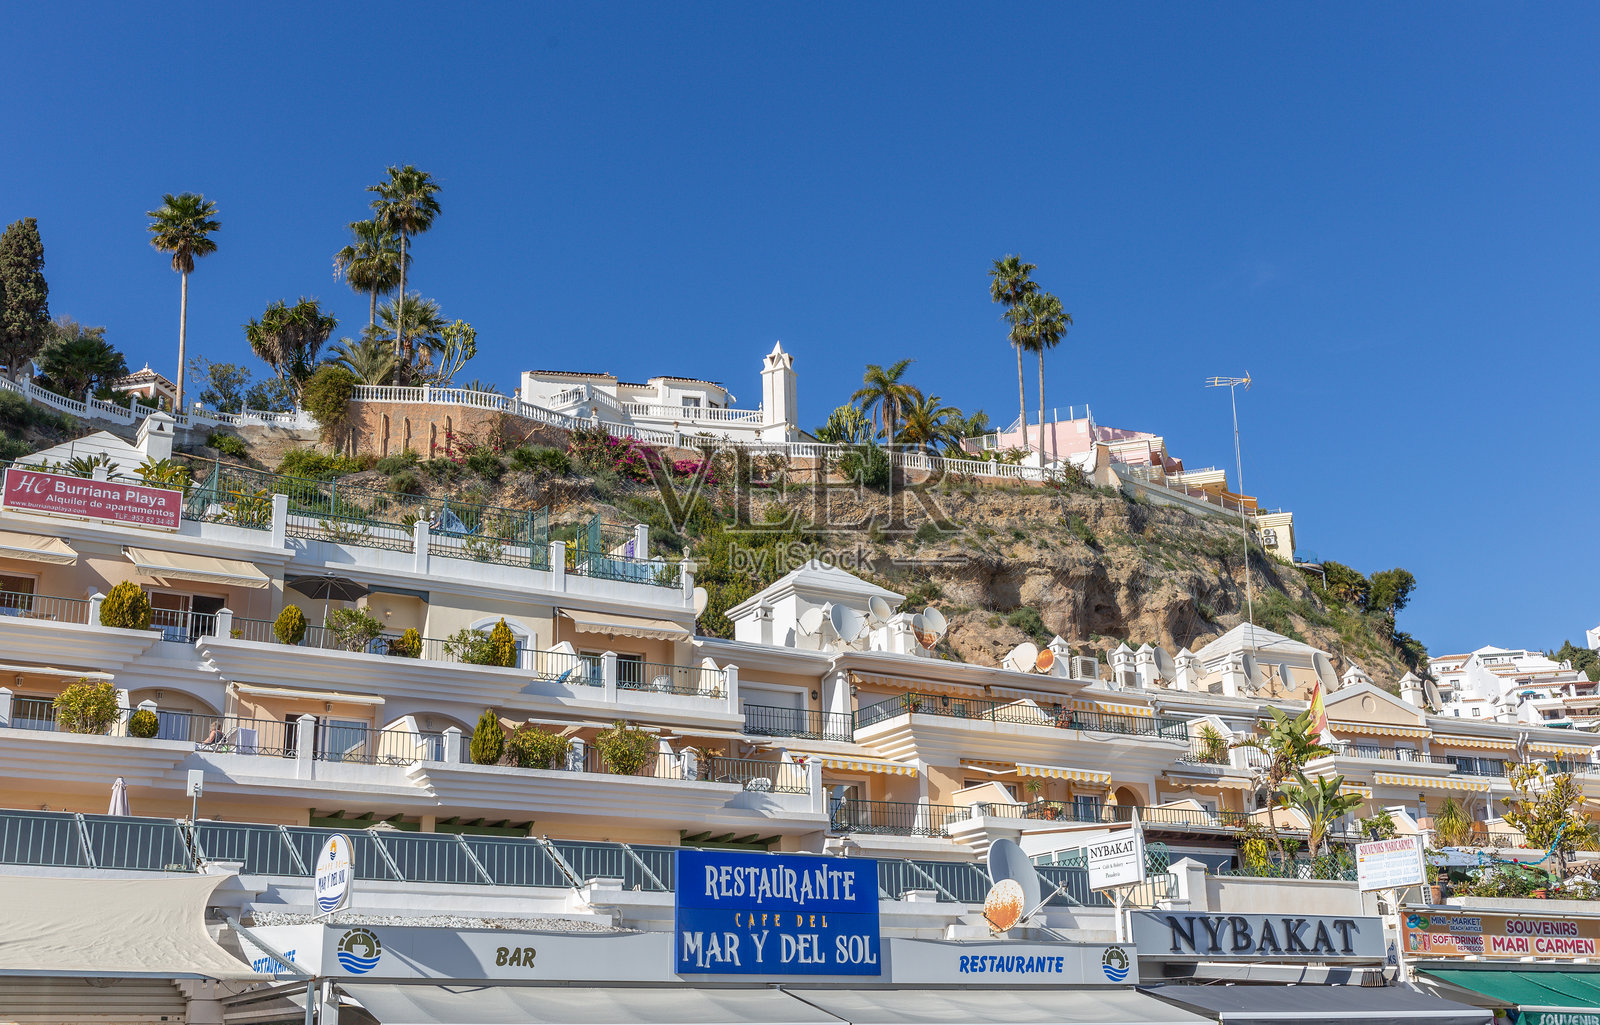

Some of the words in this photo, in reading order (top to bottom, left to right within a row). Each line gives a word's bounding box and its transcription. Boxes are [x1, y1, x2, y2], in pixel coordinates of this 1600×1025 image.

[12, 474, 50, 494] HC
[55, 480, 120, 501] Burriana
[125, 490, 166, 507] Playa
[10, 499, 87, 514] www.burrianaplaya.com
[46, 494, 87, 508] Alquiler
[90, 500, 102, 509] de
[105, 501, 175, 518] apartamentos
[1090, 841, 1134, 858] NYBAKAT
[318, 876, 327, 893] MAR
[705, 864, 856, 905] RESTAURANTE
[735, 913, 780, 929] CAFE
[796, 914, 828, 928] DEL
[1430, 916, 1446, 926] MINI
[1452, 917, 1481, 926] MARKET
[1506, 920, 1578, 936] SOUVENIRS
[1166, 916, 1357, 954] NYBAKAT
[683, 931, 741, 968] MAR
[750, 929, 770, 964] Y
[780, 933, 826, 965] DEL
[835, 934, 877, 965] SOL
[1492, 936, 1529, 953] MARI
[1535, 938, 1595, 954] CARMEN
[496, 946, 537, 969] BAR
[959, 955, 1065, 975] RESTAURANTE
